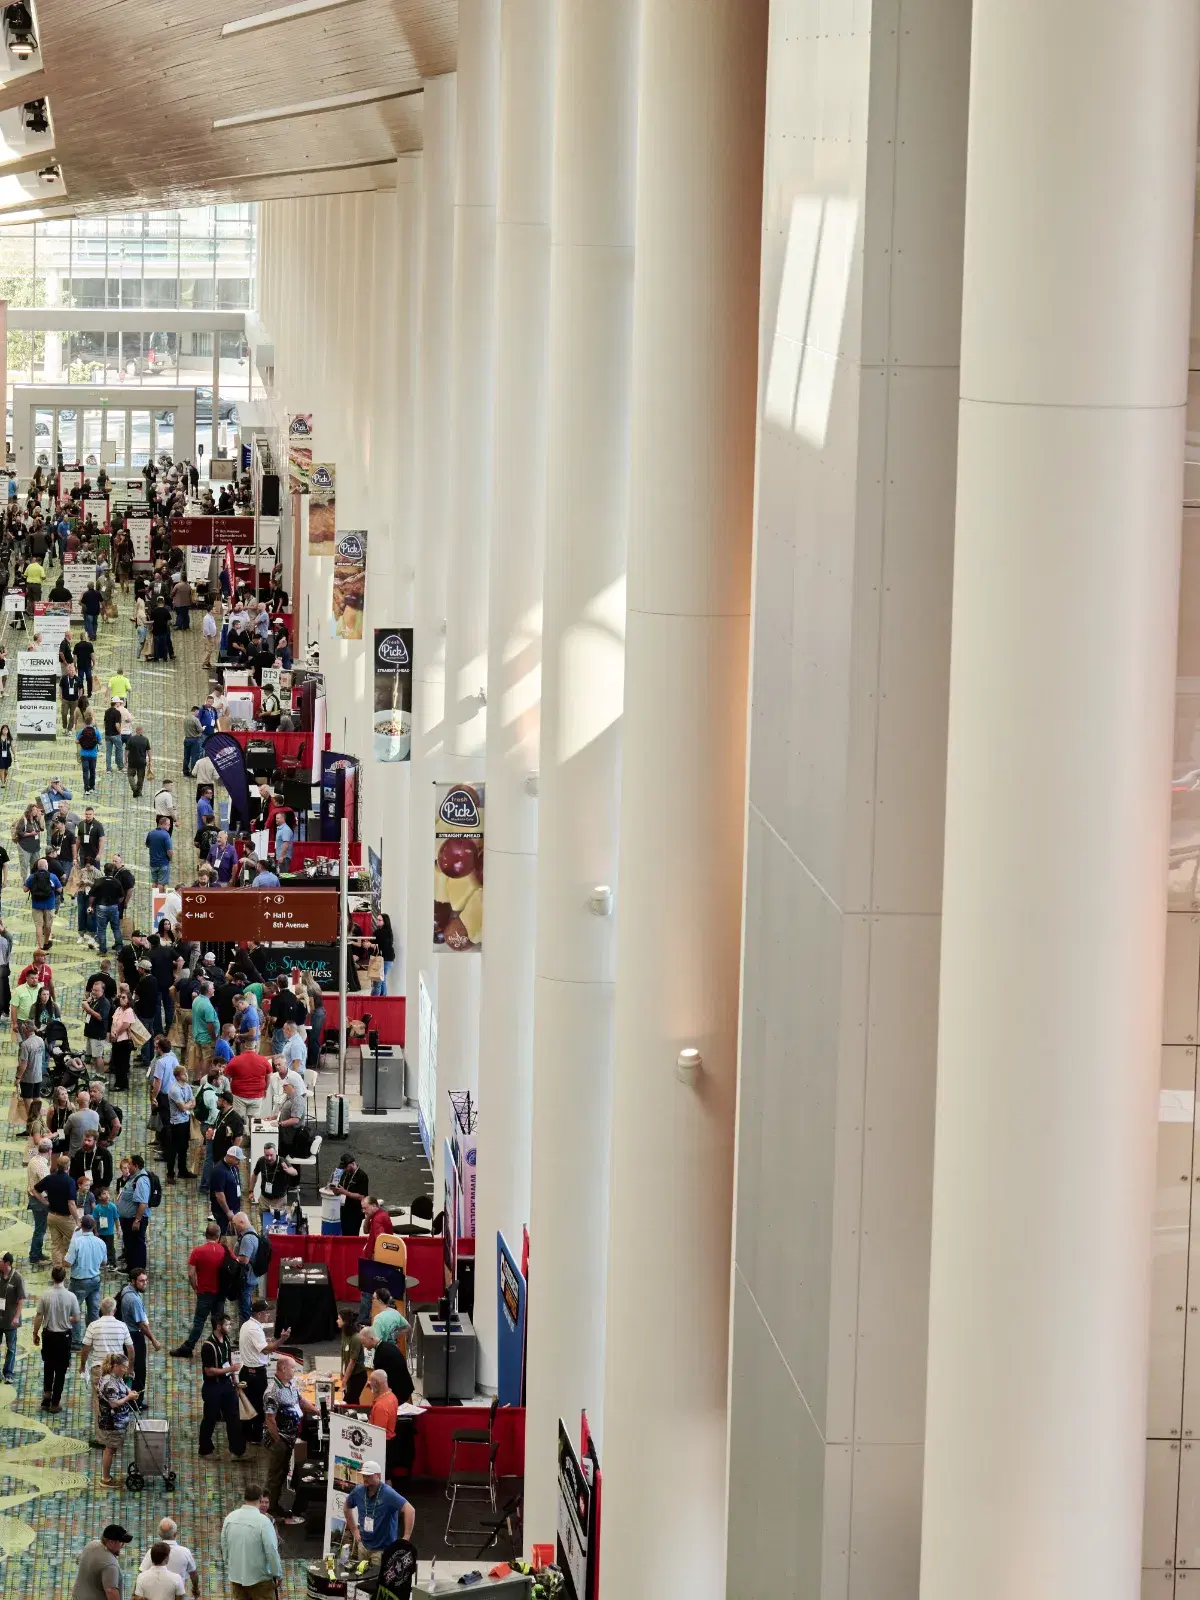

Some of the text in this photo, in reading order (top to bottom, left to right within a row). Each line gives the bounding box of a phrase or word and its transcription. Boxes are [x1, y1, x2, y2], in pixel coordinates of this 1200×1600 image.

[294, 423, 308, 431] Pick
[314, 474, 331, 483] Pick
[341, 543, 360, 553] Pick
[381, 644, 406, 657] Pick
[444, 802, 476, 818] Pick
[281, 956, 326, 970] SUNCOR
[351, 1452, 363, 1460] USA
